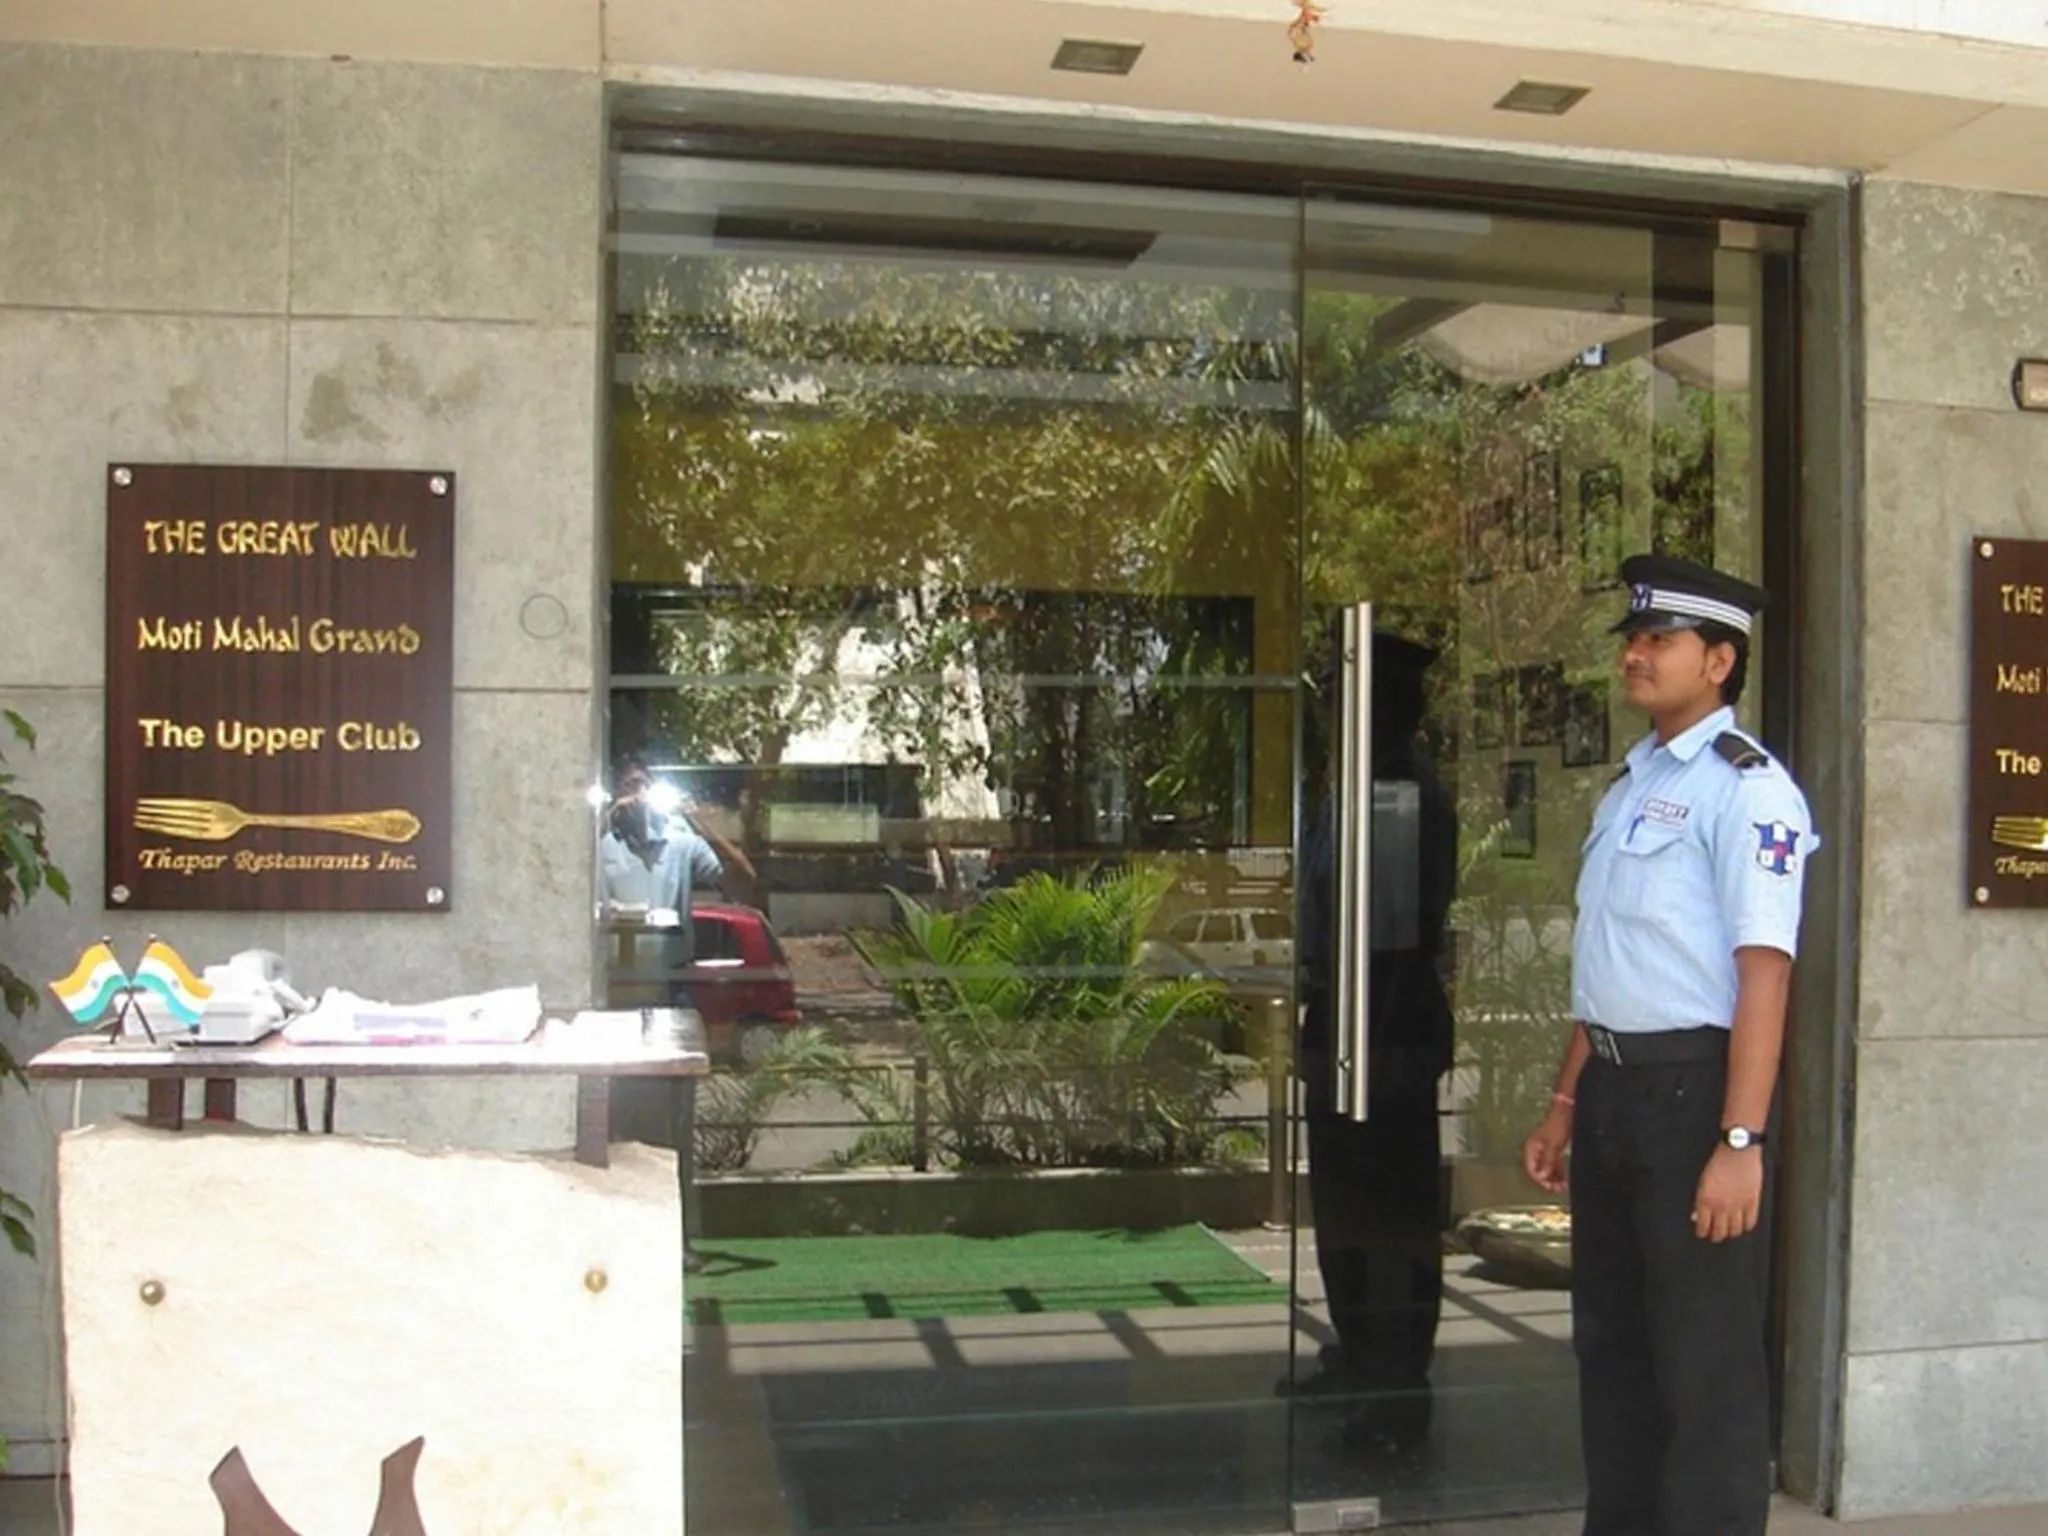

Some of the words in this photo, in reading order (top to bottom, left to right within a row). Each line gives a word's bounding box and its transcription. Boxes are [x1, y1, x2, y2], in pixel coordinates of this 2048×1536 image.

[144, 520, 206, 555] THE
[217, 520, 320, 556] GREAT
[330, 522, 417, 558] WALL
[2001, 584, 2044, 615] THE
[138, 615, 202, 651] Moti
[213, 615, 300, 652] Mahal
[308, 617, 420, 655] Grand
[1996, 663, 2040, 694] Moti
[138, 719, 205, 748] The
[216, 720, 325, 755] Upper
[337, 721, 421, 751] Club
[1995, 748, 2042, 775] The
[138, 847, 228, 875] Thapar
[234, 849, 371, 873] Restaurants
[376, 850, 417, 871] Inc.
[1994, 855, 2048, 880] Thapa
